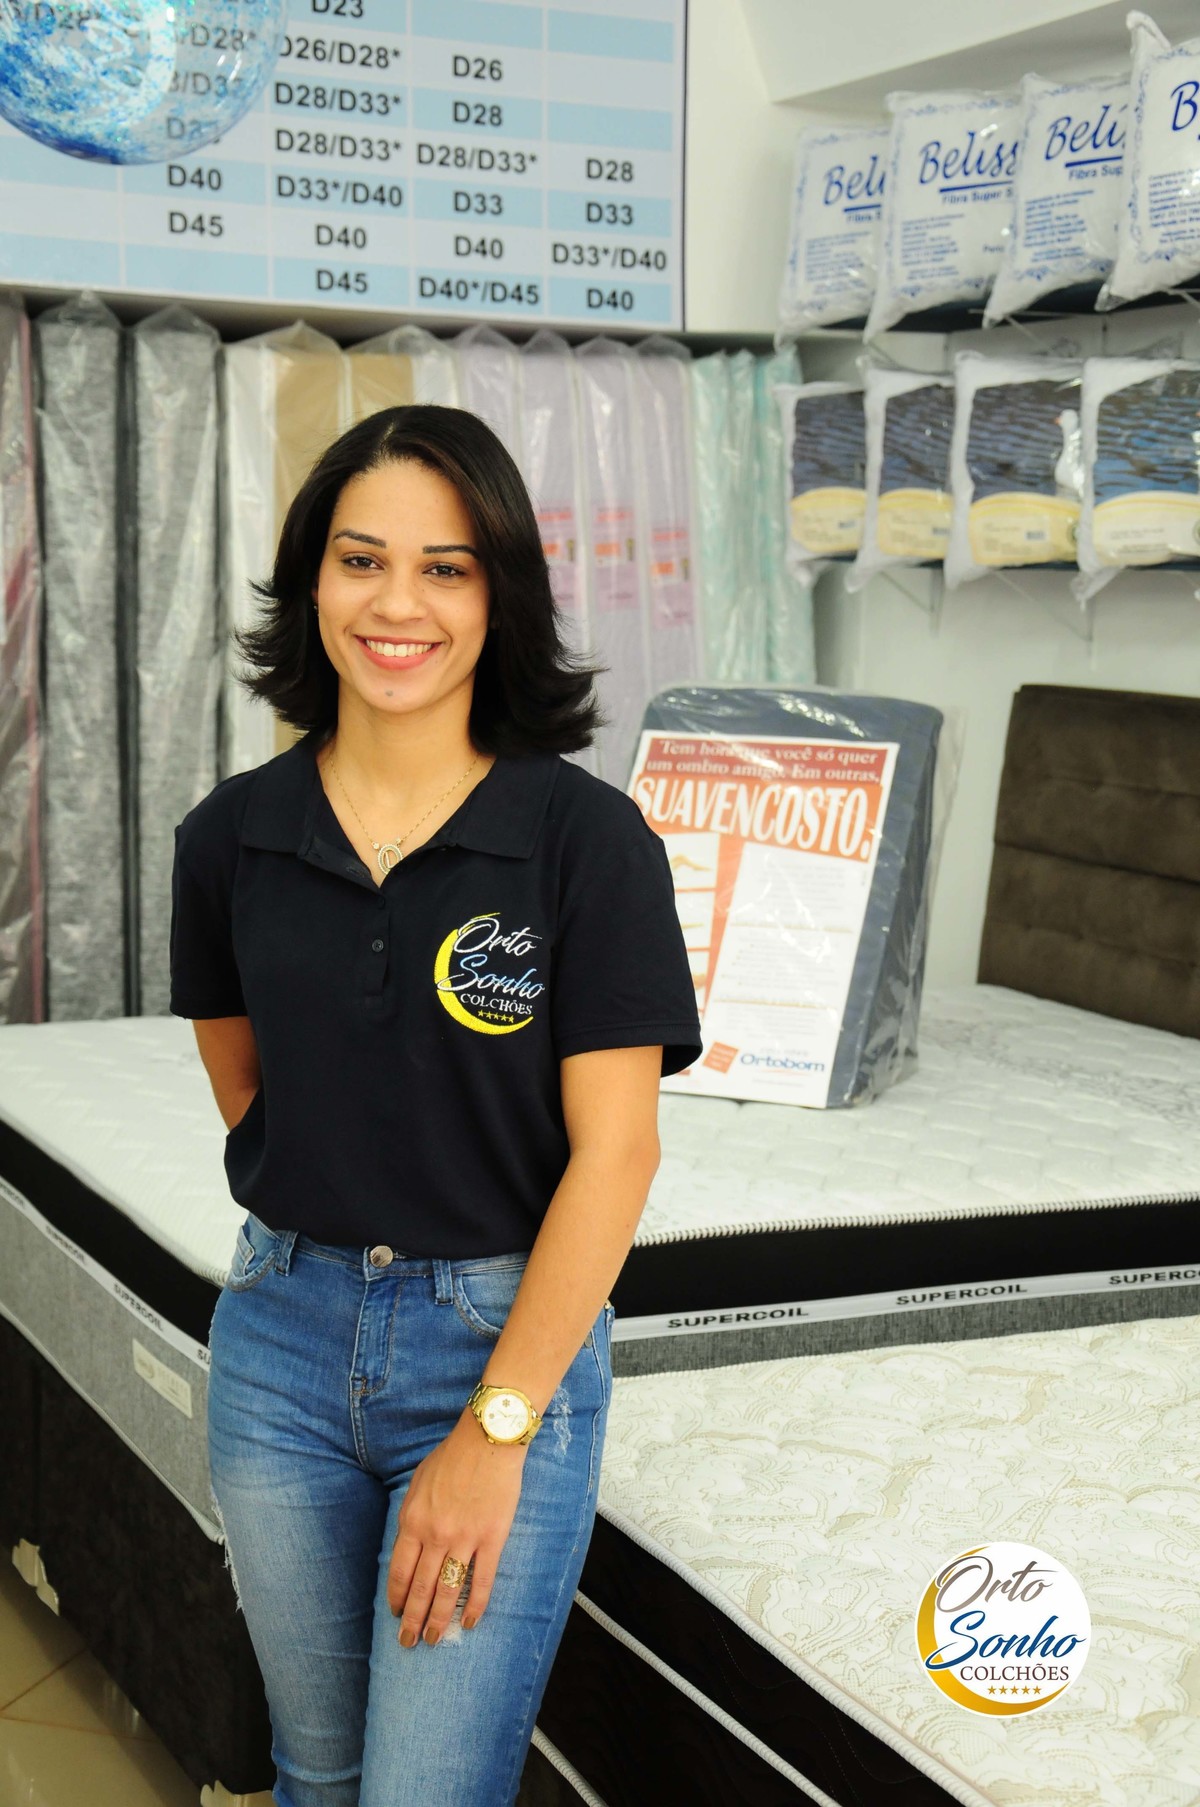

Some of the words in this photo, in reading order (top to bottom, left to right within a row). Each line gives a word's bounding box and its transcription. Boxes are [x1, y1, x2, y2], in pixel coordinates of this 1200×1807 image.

[453, 54, 503, 82] D26
[452, 100, 503, 128] D28
[1044, 104, 1127, 161] Beli
[167, 163, 223, 192] D40
[586, 158, 634, 183] D28
[453, 190, 504, 217] D33
[585, 201, 634, 227] D33
[168, 210, 224, 238] D45
[315, 224, 367, 250] D40
[454, 235, 504, 260] D40
[316, 268, 369, 294] D45
[586, 287, 635, 312] D40
[659, 740, 695, 755] Tem
[775, 748, 813, 762] você
[815, 749, 835, 762] só
[837, 751, 878, 766] quer
[646, 760, 673, 772] um
[676, 759, 729, 774] ombro
[791, 766, 821, 780] Em
[634, 777, 872, 860] SUAVENCOSTO.
[454, 917, 543, 957] Orto
[437, 953, 546, 1000] Sonho
[460, 993, 533, 1016] COLCHÕES
[1108, 1269, 1200, 1285] SUPERC
[895, 1283, 1028, 1306] SUPERCOIL
[667, 1307, 809, 1329] SUPERCOIL
